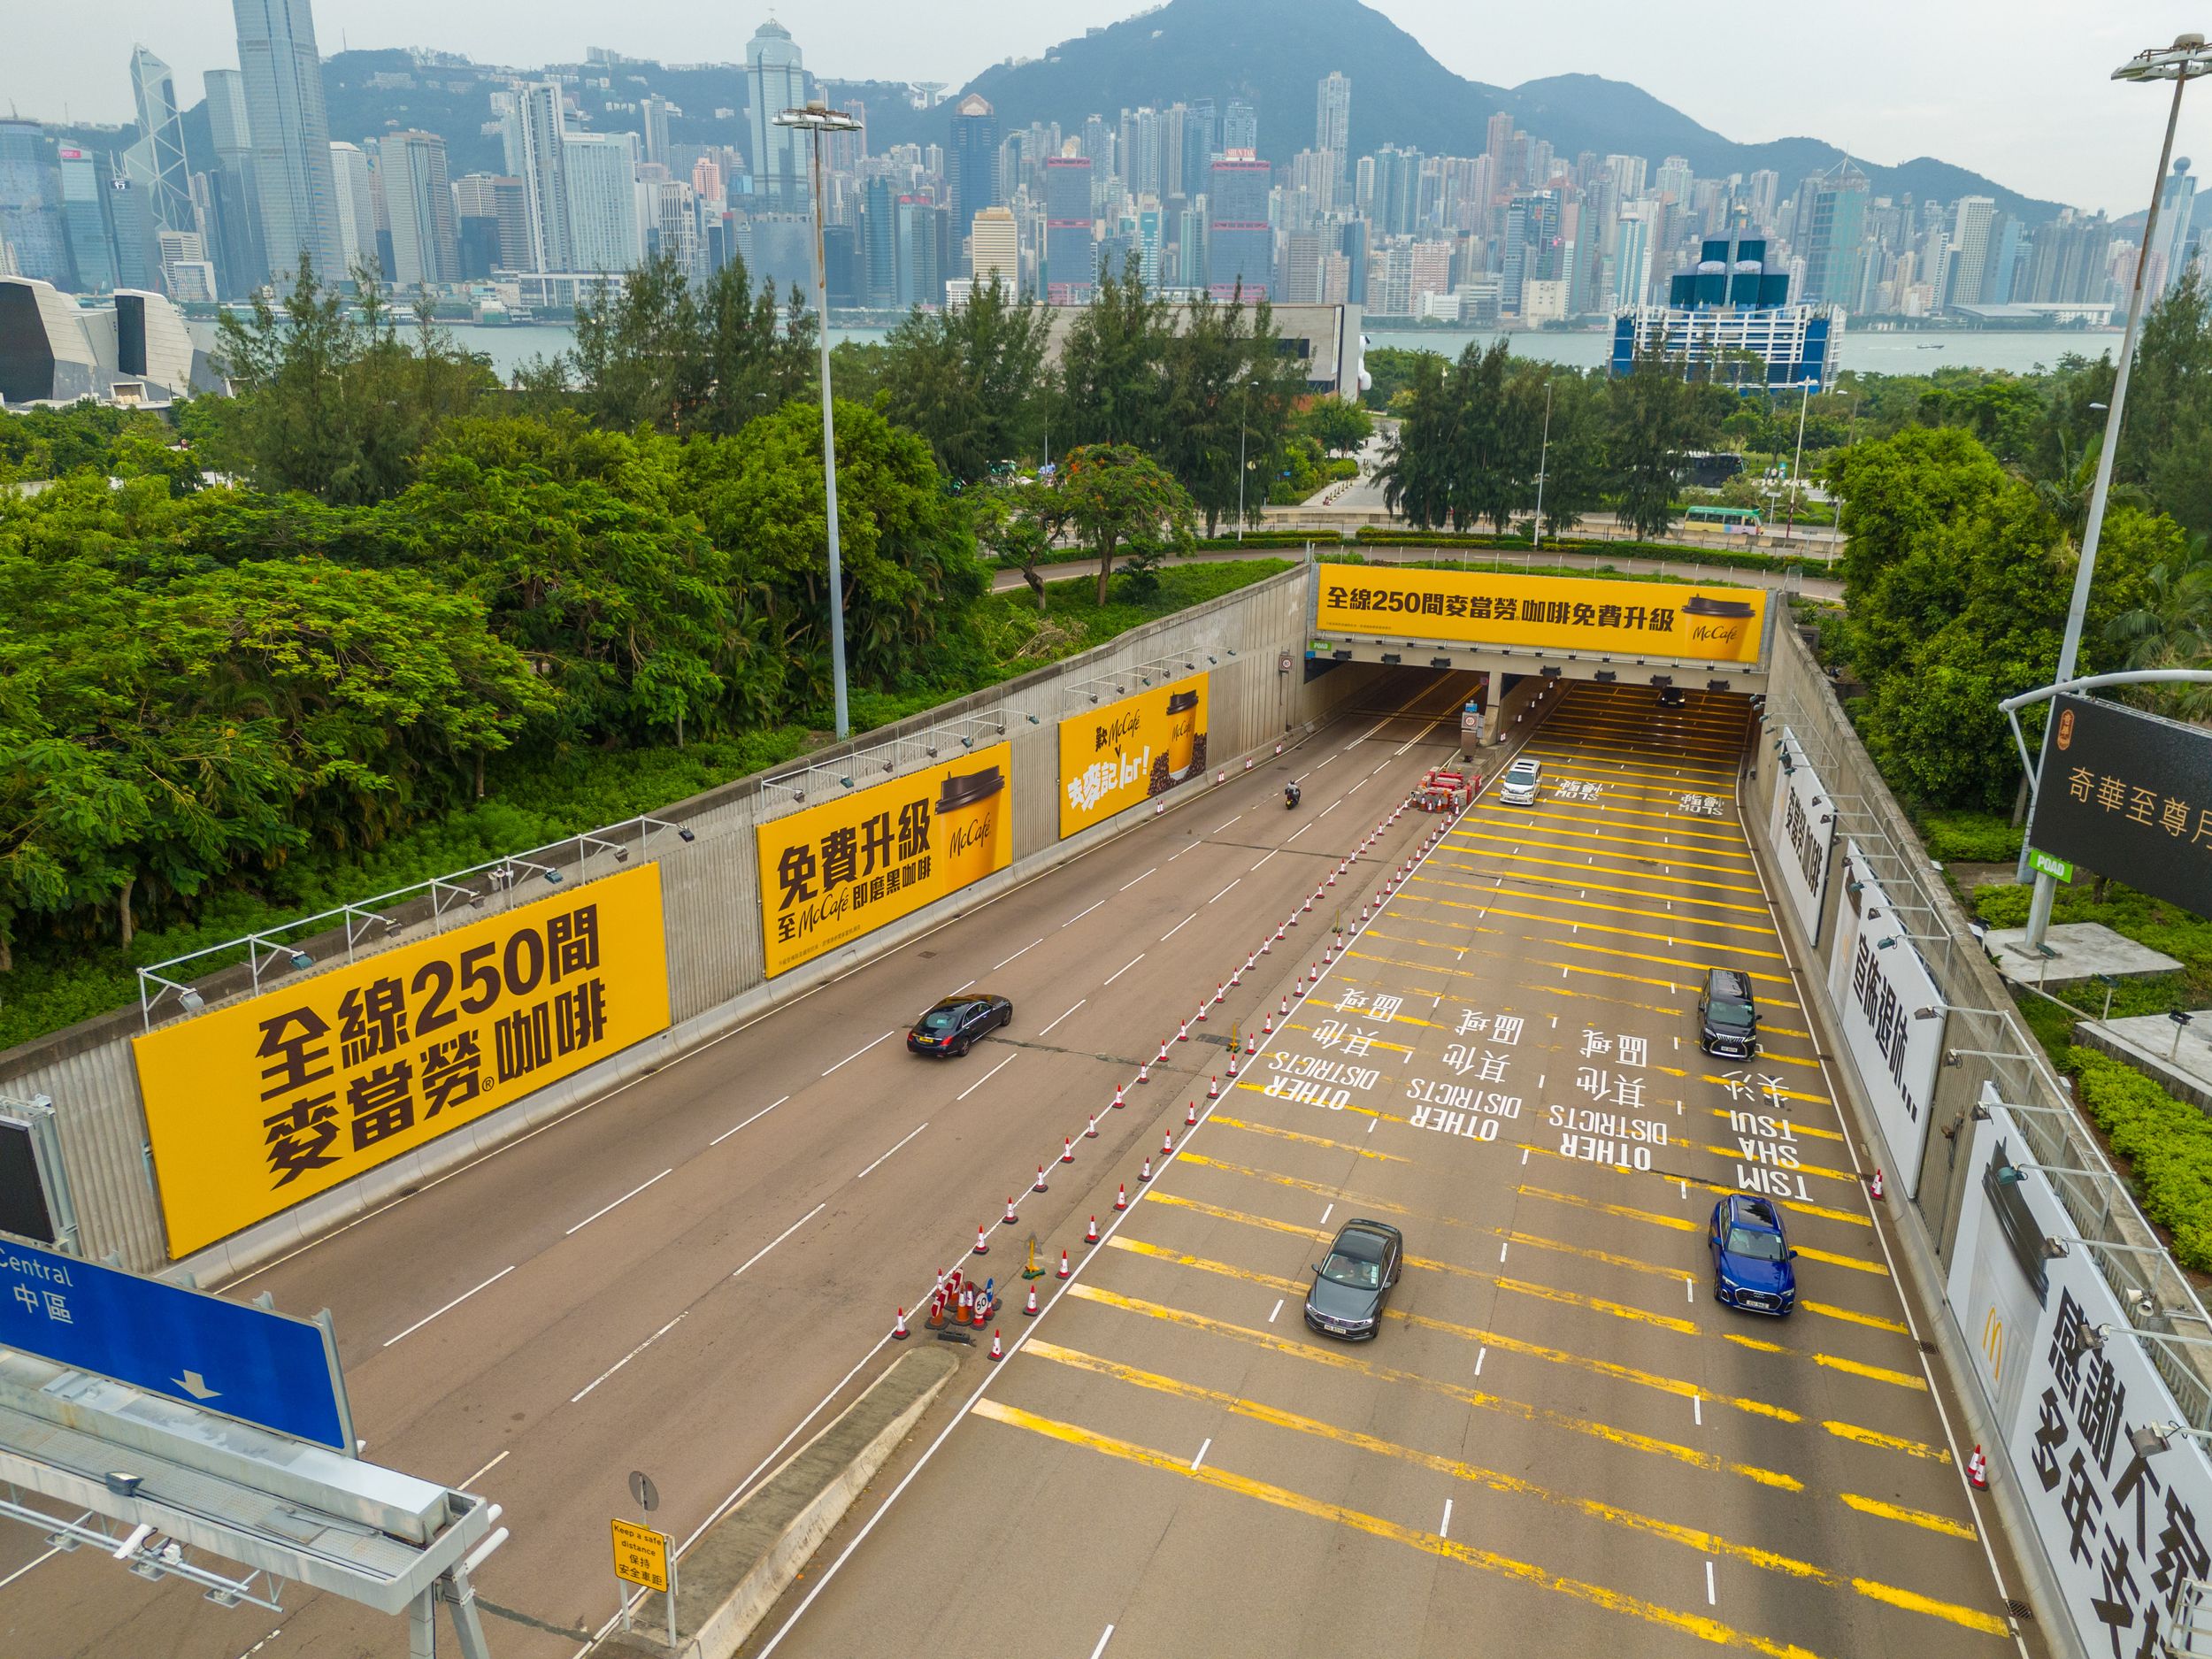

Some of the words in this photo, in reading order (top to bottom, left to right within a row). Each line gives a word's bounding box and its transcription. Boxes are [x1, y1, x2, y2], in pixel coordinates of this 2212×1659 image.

[1693, 625, 1738, 644] McCafé
[1554, 790, 1600, 802] SLOW
[1678, 803, 1724, 816] SLOW
[949, 811, 992, 859] McCafé
[778, 797, 931, 912] 免費升級
[2036, 854, 2065, 878] POAD
[255, 903, 601, 1102] 全線250間
[1333, 987, 1404, 1024] 區域
[1311, 1019, 1381, 1057] 其他
[1455, 1009, 1525, 1046] 區域
[1442, 1043, 1512, 1084] 其他
[1579, 1029, 1647, 1068] 區域
[1268, 1051, 1381, 1091] DISTRICTS
[1576, 1066, 1647, 1109] 其他
[1263, 1075, 1351, 1110] OTHER
[1406, 1078, 1523, 1119] DISTRICTS
[1409, 1104, 1501, 1141] OTHER
[1548, 1104, 1668, 1146] DISTRICTS
[1730, 1110, 1798, 1142] TSUI
[1560, 1133, 1651, 1171] OTHER
[1738, 1137, 1801, 1169] SHA
[1737, 1164, 1814, 1202] TSIM
[13, 1283, 74, 1325] 中區
[976, 1297, 987, 1311] 50
[614, 1525, 634, 1538] Keep
[644, 1535, 663, 1547] safe
[621, 1540, 657, 1557] distance
[618, 1563, 663, 1586] 安全車距
[629, 1554, 650, 1570] 保持
